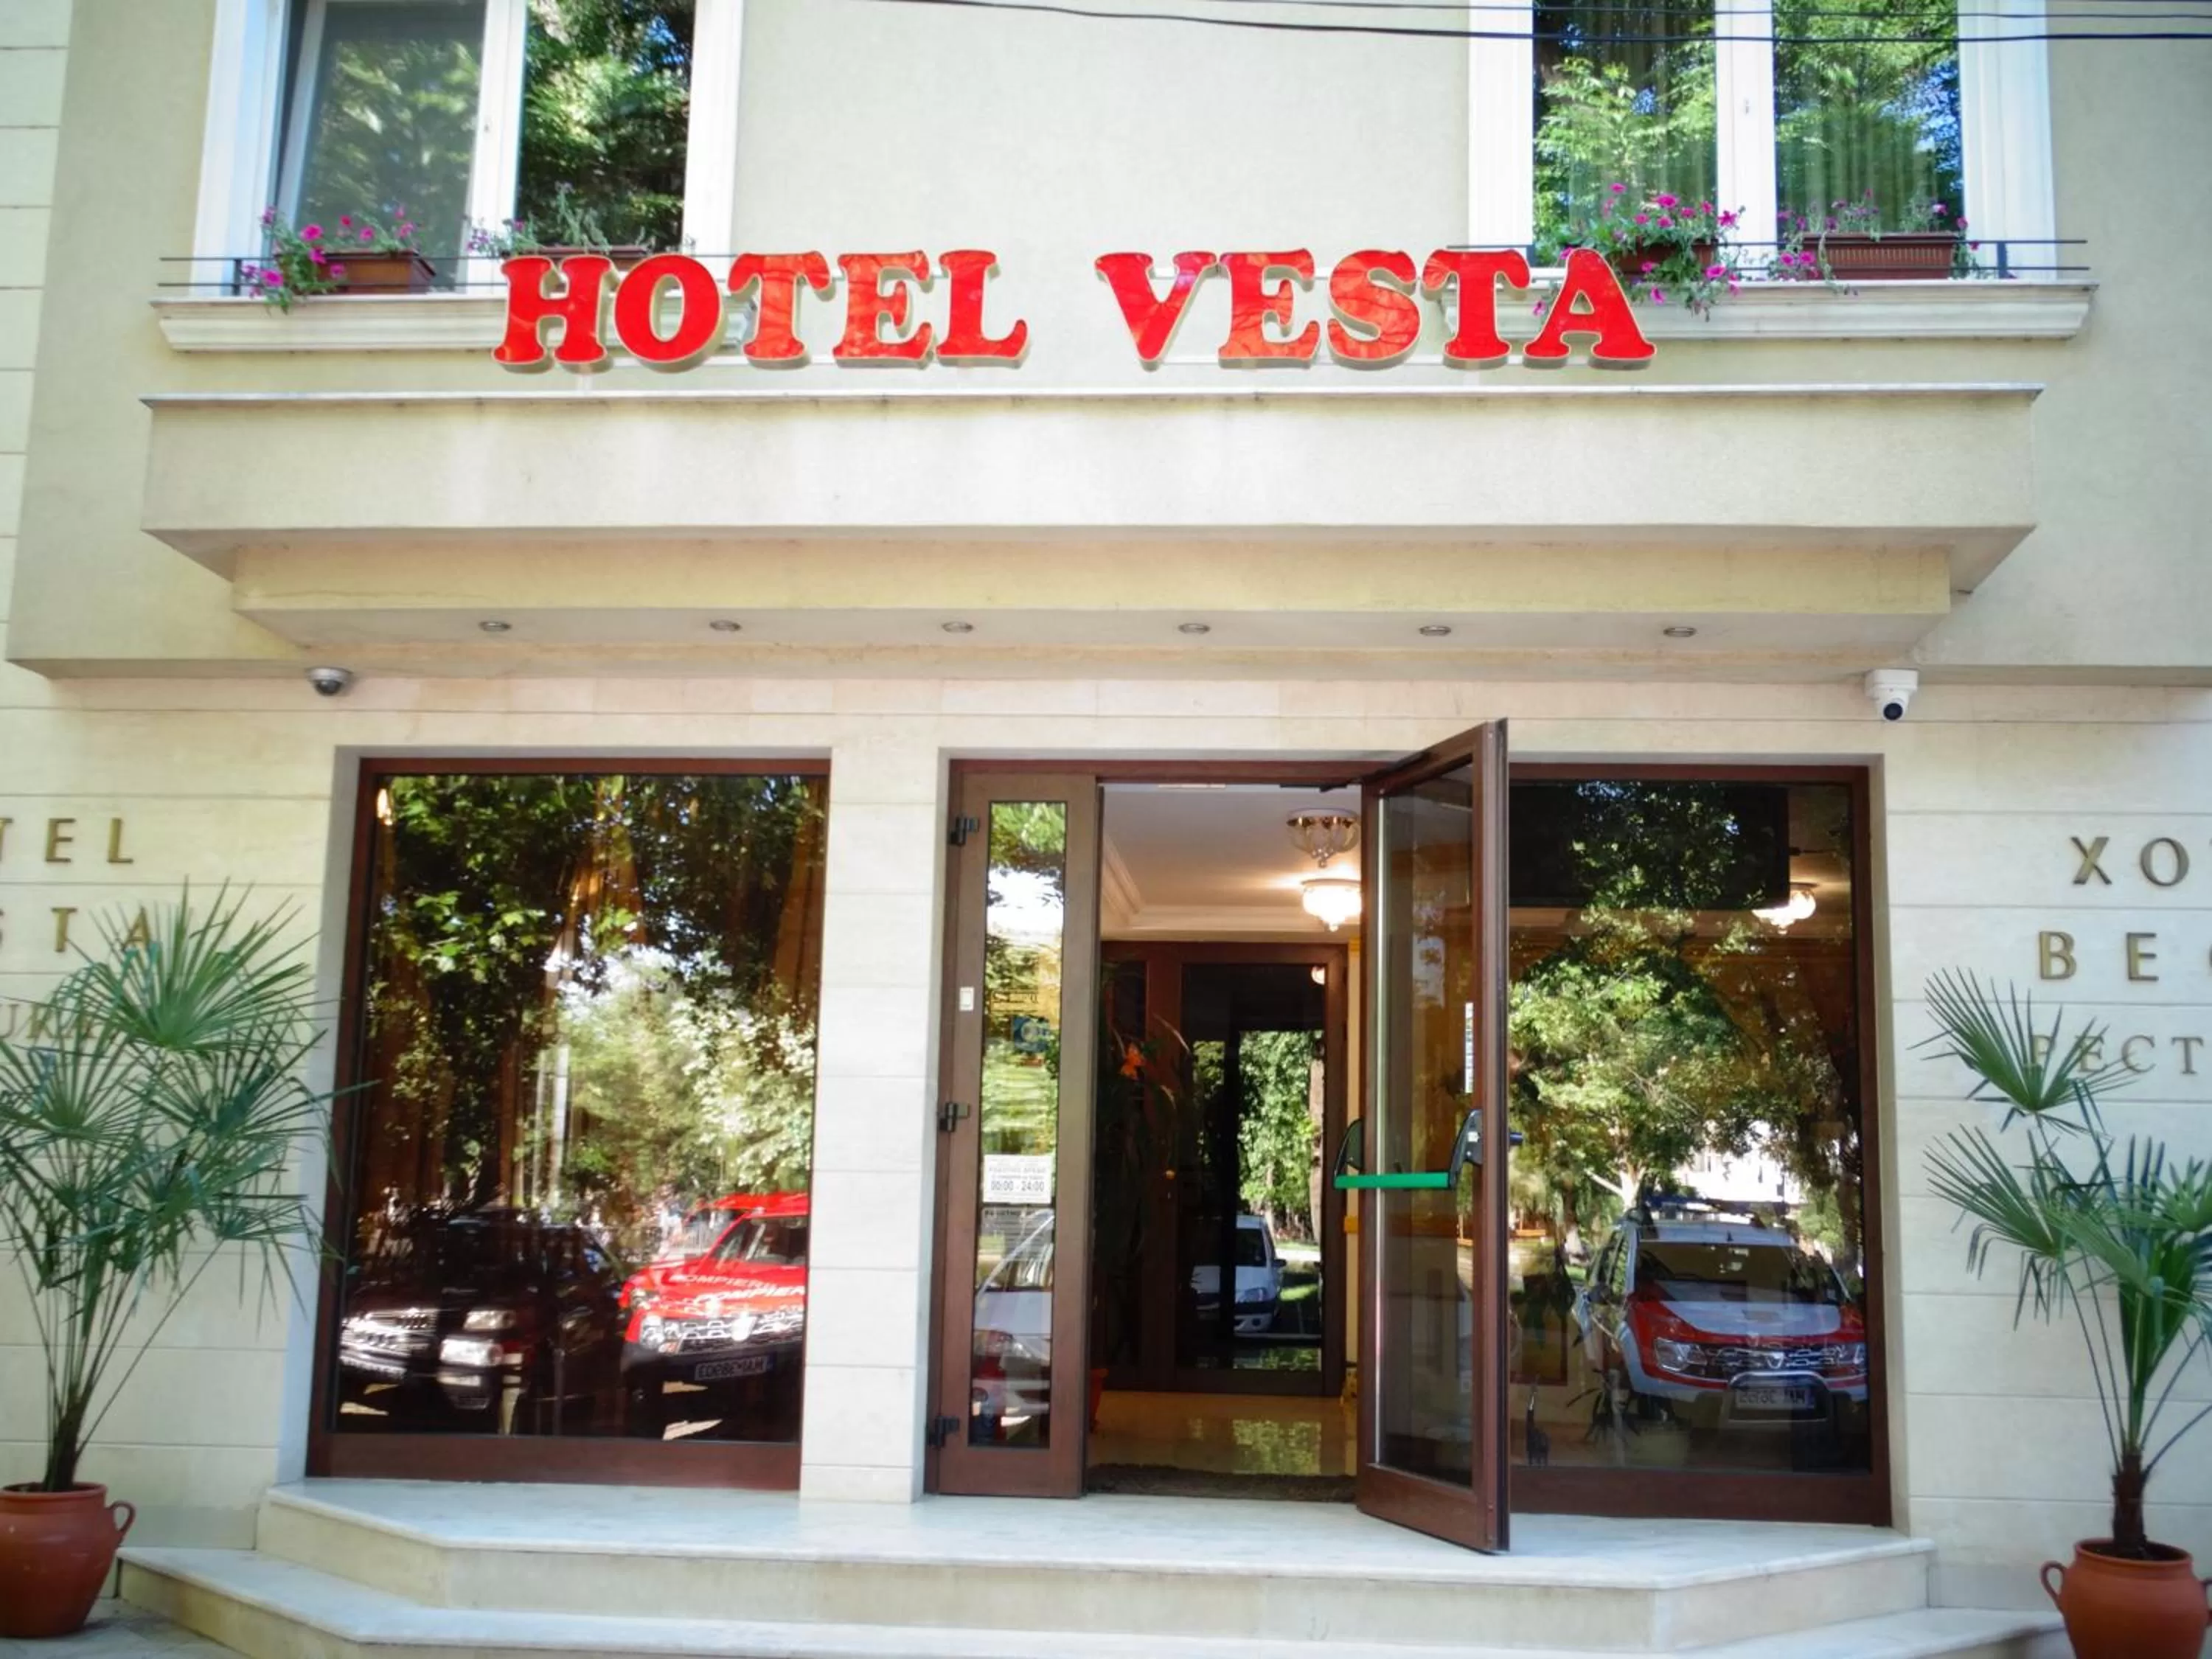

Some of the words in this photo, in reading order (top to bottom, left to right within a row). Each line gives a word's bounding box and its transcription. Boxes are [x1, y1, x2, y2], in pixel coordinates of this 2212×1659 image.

[492, 251, 1029, 370] HOTEL
[1094, 248, 1658, 369] VESTA
[2071, 836, 2212, 886] ХО
[0, 907, 153, 952] TA
[2039, 931, 2212, 981] ВЕ
